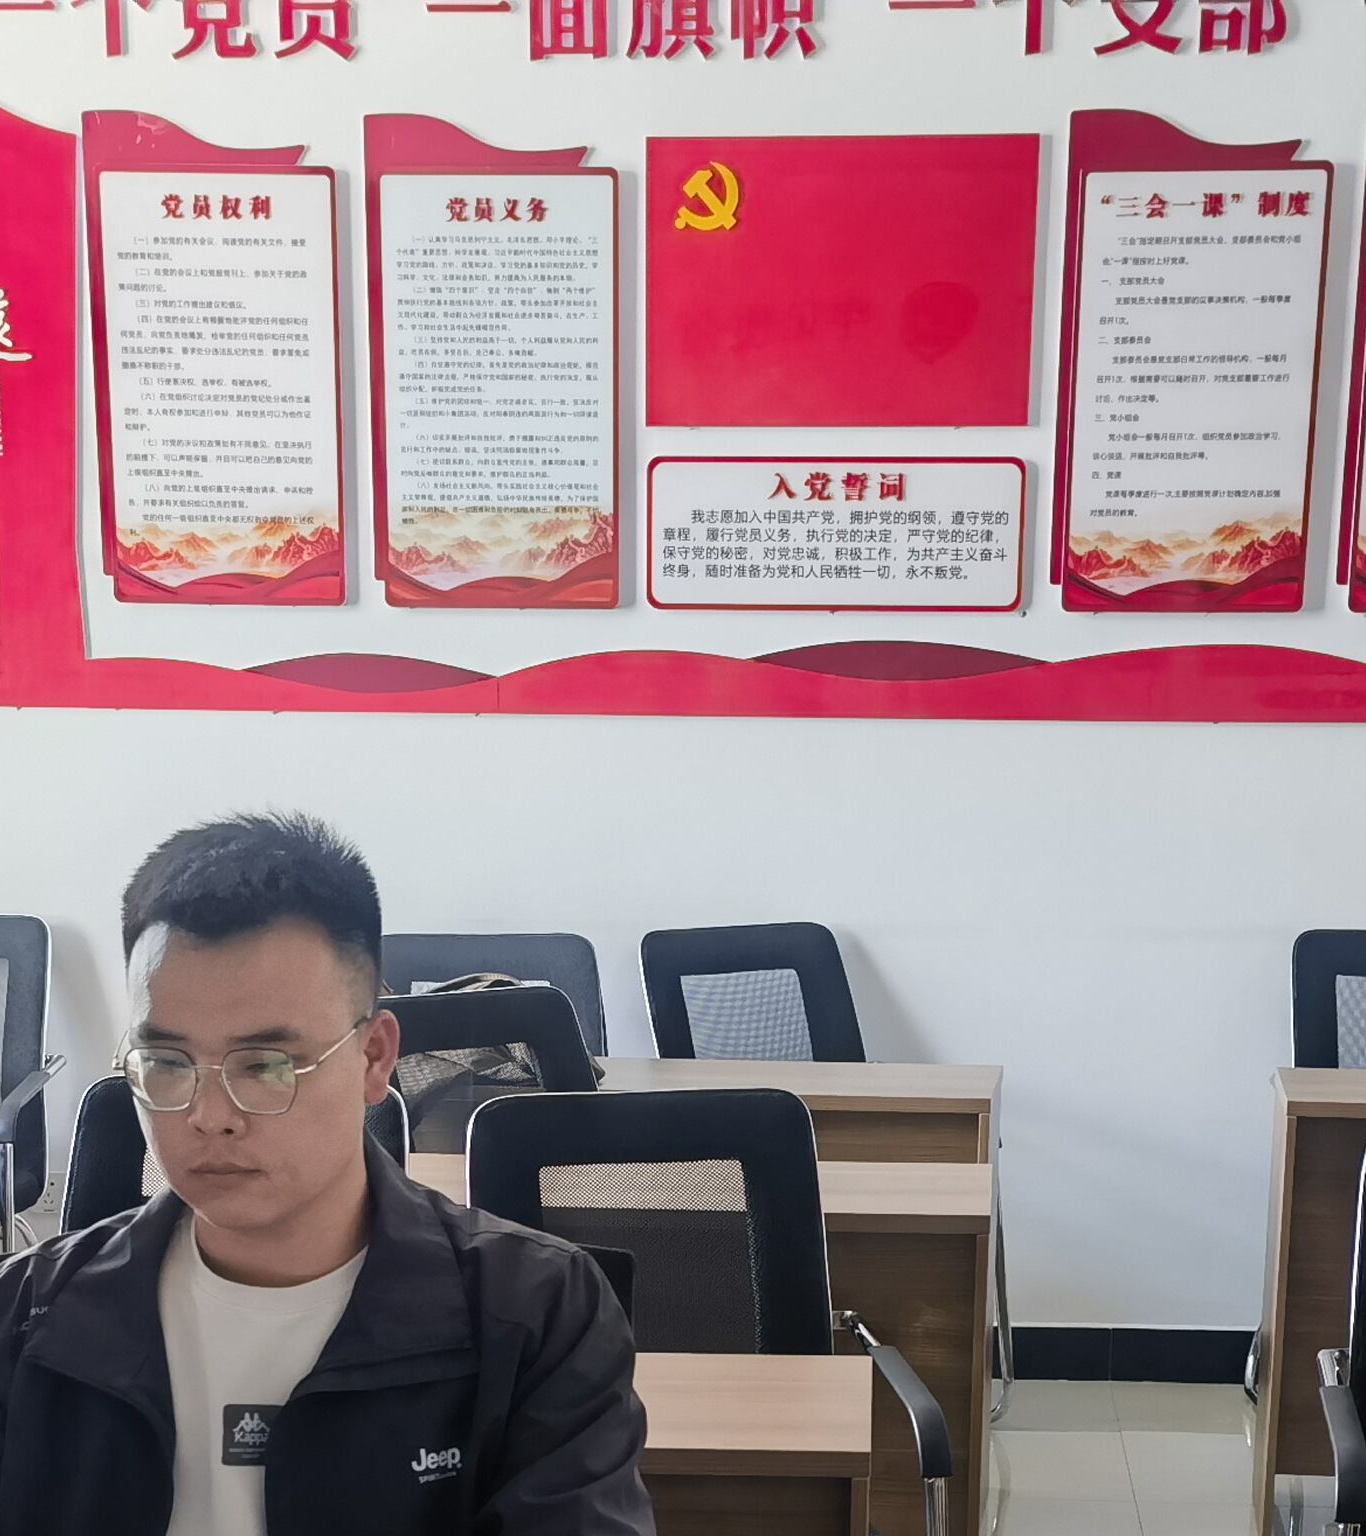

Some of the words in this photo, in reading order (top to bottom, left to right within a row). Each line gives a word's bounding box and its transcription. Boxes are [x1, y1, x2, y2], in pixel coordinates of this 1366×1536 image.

[161, 193, 273, 220] 党员权利
[446, 197, 549, 223] 党员义务
[768, 472, 907, 501] 入党誓词
[691, 509, 1010, 526] 我志愿加入中国共产党，拥护党的纲领，遵守党的
[663, 545, 1008, 564] 保守党的秘密，对党忠诚，积极工作，为共产主义奋斗
[662, 563, 968, 580] 终身，随时准备为党和人民牺牲一切，永不叛党。
[411, 1447, 461, 1472] Jeep
